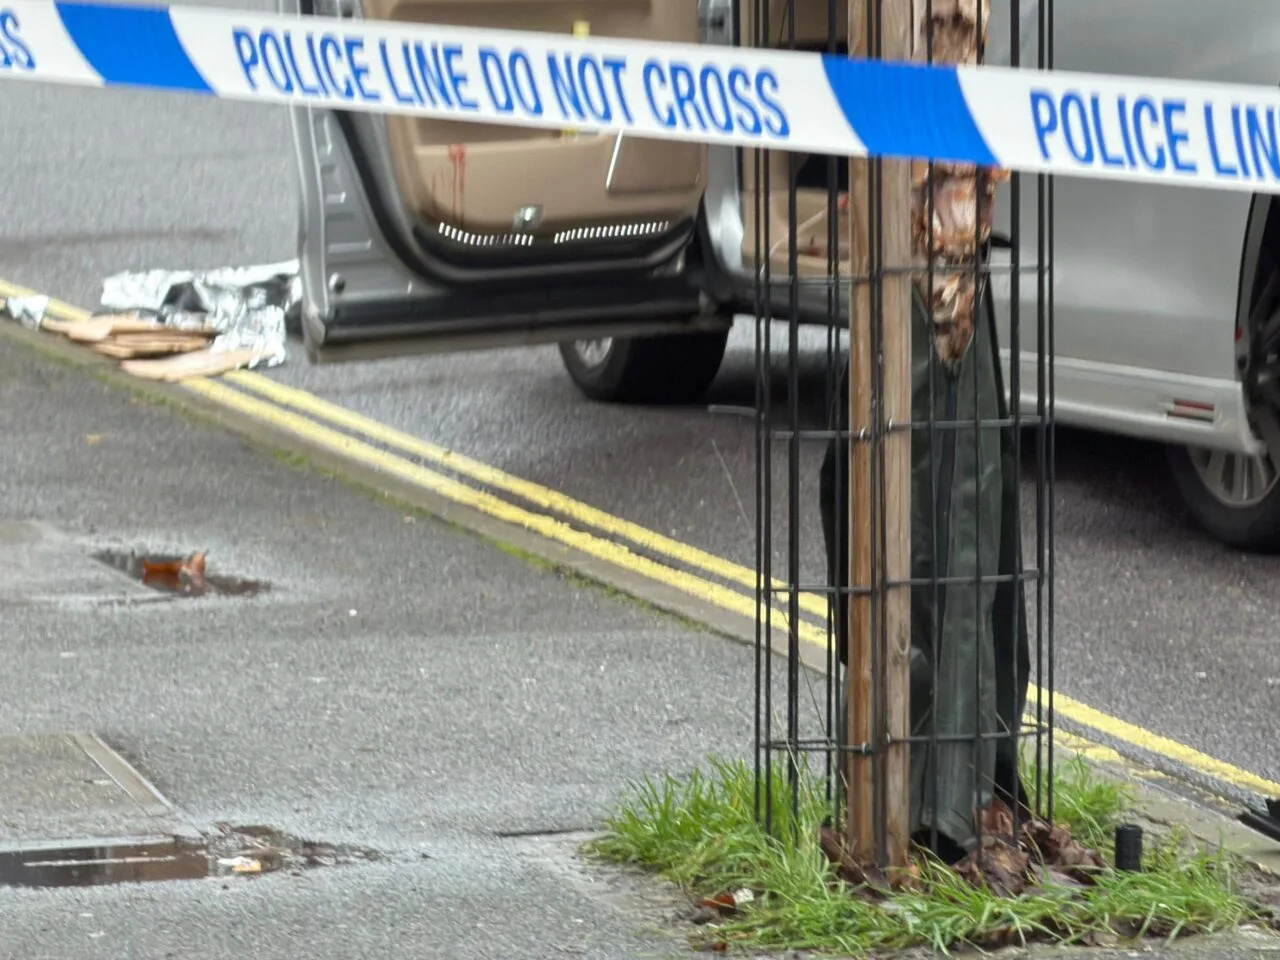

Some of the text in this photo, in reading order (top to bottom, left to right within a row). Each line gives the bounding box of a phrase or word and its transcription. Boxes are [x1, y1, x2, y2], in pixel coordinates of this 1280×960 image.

[233, 27, 790, 139] POLICE LINE DO NOT CROSS
[1030, 89, 1197, 174] POLICE
